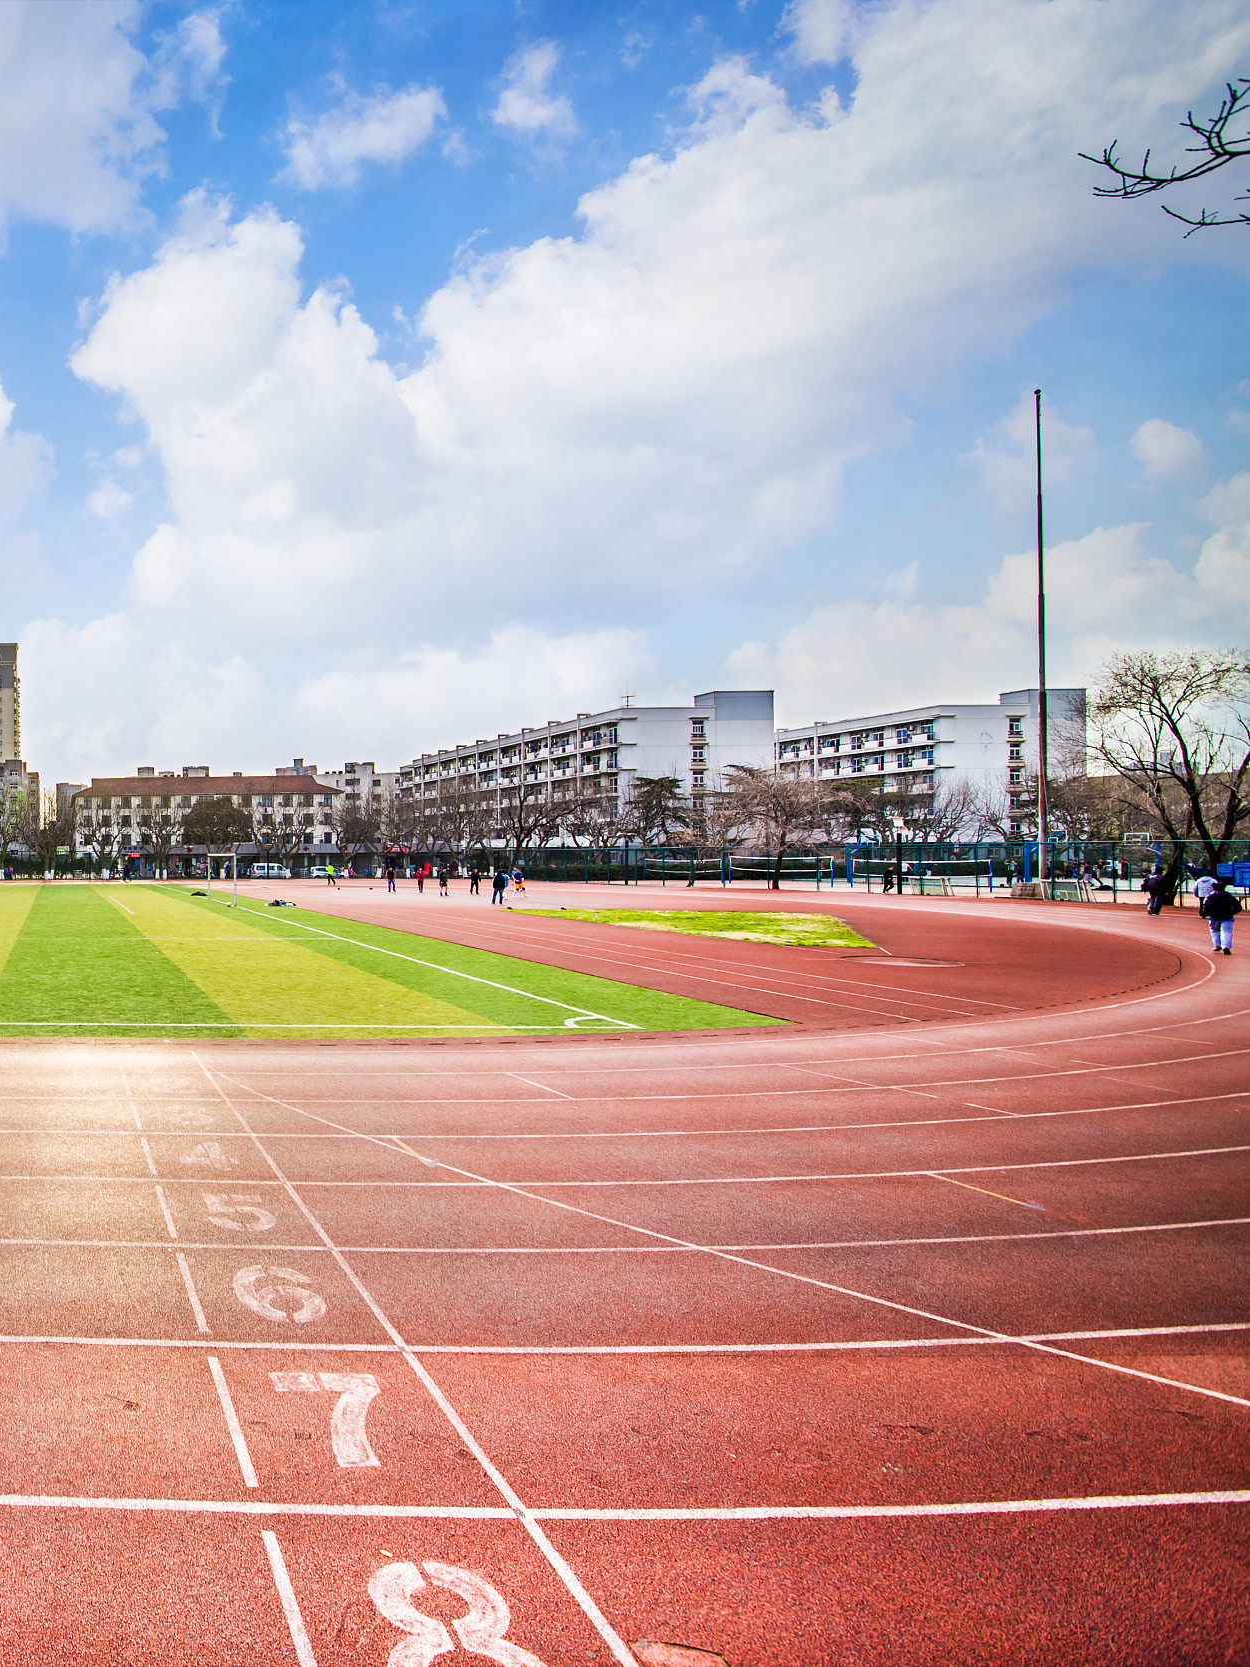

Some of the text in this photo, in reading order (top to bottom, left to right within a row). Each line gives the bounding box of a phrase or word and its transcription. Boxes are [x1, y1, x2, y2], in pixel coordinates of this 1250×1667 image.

[165, 1104, 214, 1126] 3
[180, 1142, 240, 1171] 4
[202, 1193, 276, 1231] 5
[233, 1265, 327, 1323] 6
[268, 1372, 382, 1468] 7
[367, 1560, 548, 1667] 8
